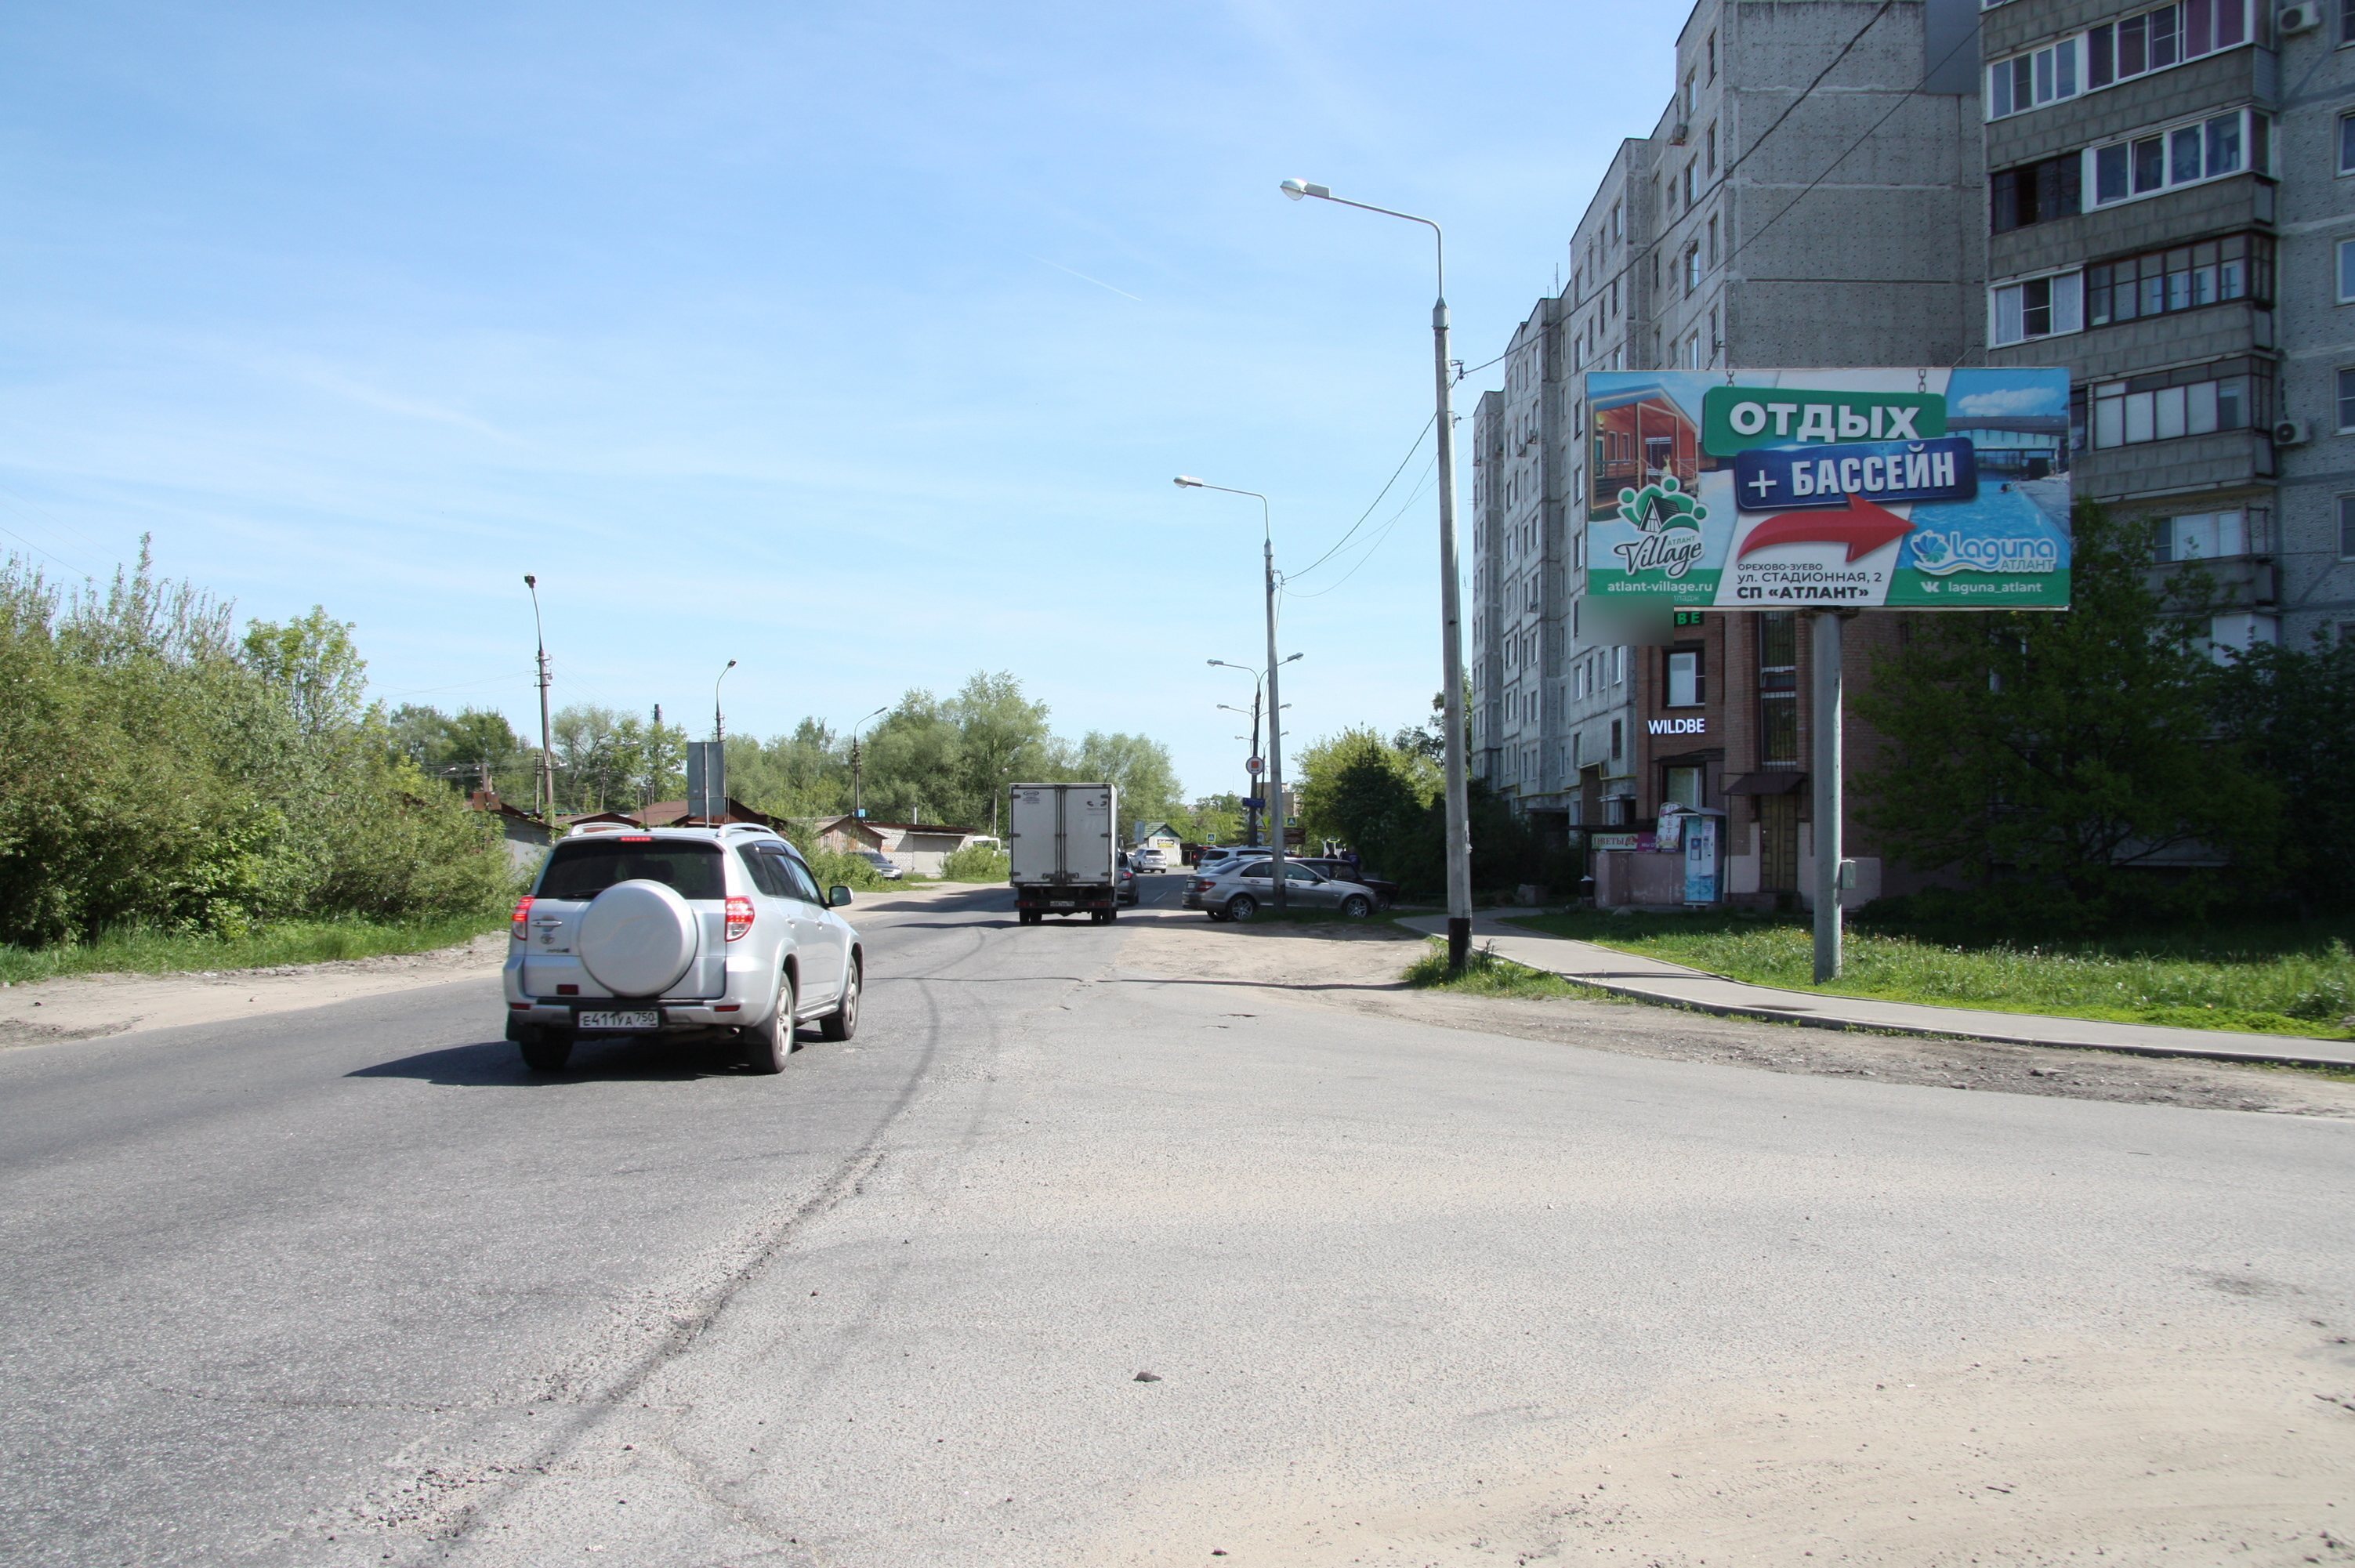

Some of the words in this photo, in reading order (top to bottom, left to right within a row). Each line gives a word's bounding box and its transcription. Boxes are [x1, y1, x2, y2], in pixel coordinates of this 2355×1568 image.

[1729, 401, 1921, 444] ОТДЫХ
[1792, 443, 1955, 497] БАССЕЙН
[1667, 535, 1696, 547] АТЛАНТ
[1613, 535, 1702, 577] Village
[2000, 559, 2055, 570] АТЛАНТ
[1737, 574, 1758, 585] ул.
[1761, 572, 1871, 584] СТАДИОННАЯ,
[1874, 572, 1882, 582] 2
[1607, 581, 1713, 593] atlant-village.ru
[1737, 586, 1763, 599] СП
[1768, 586, 1869, 599] «АТЛАНТ»
[1948, 581, 2043, 595] laguna_atlant
[1647, 718, 1705, 735] WILDBE
